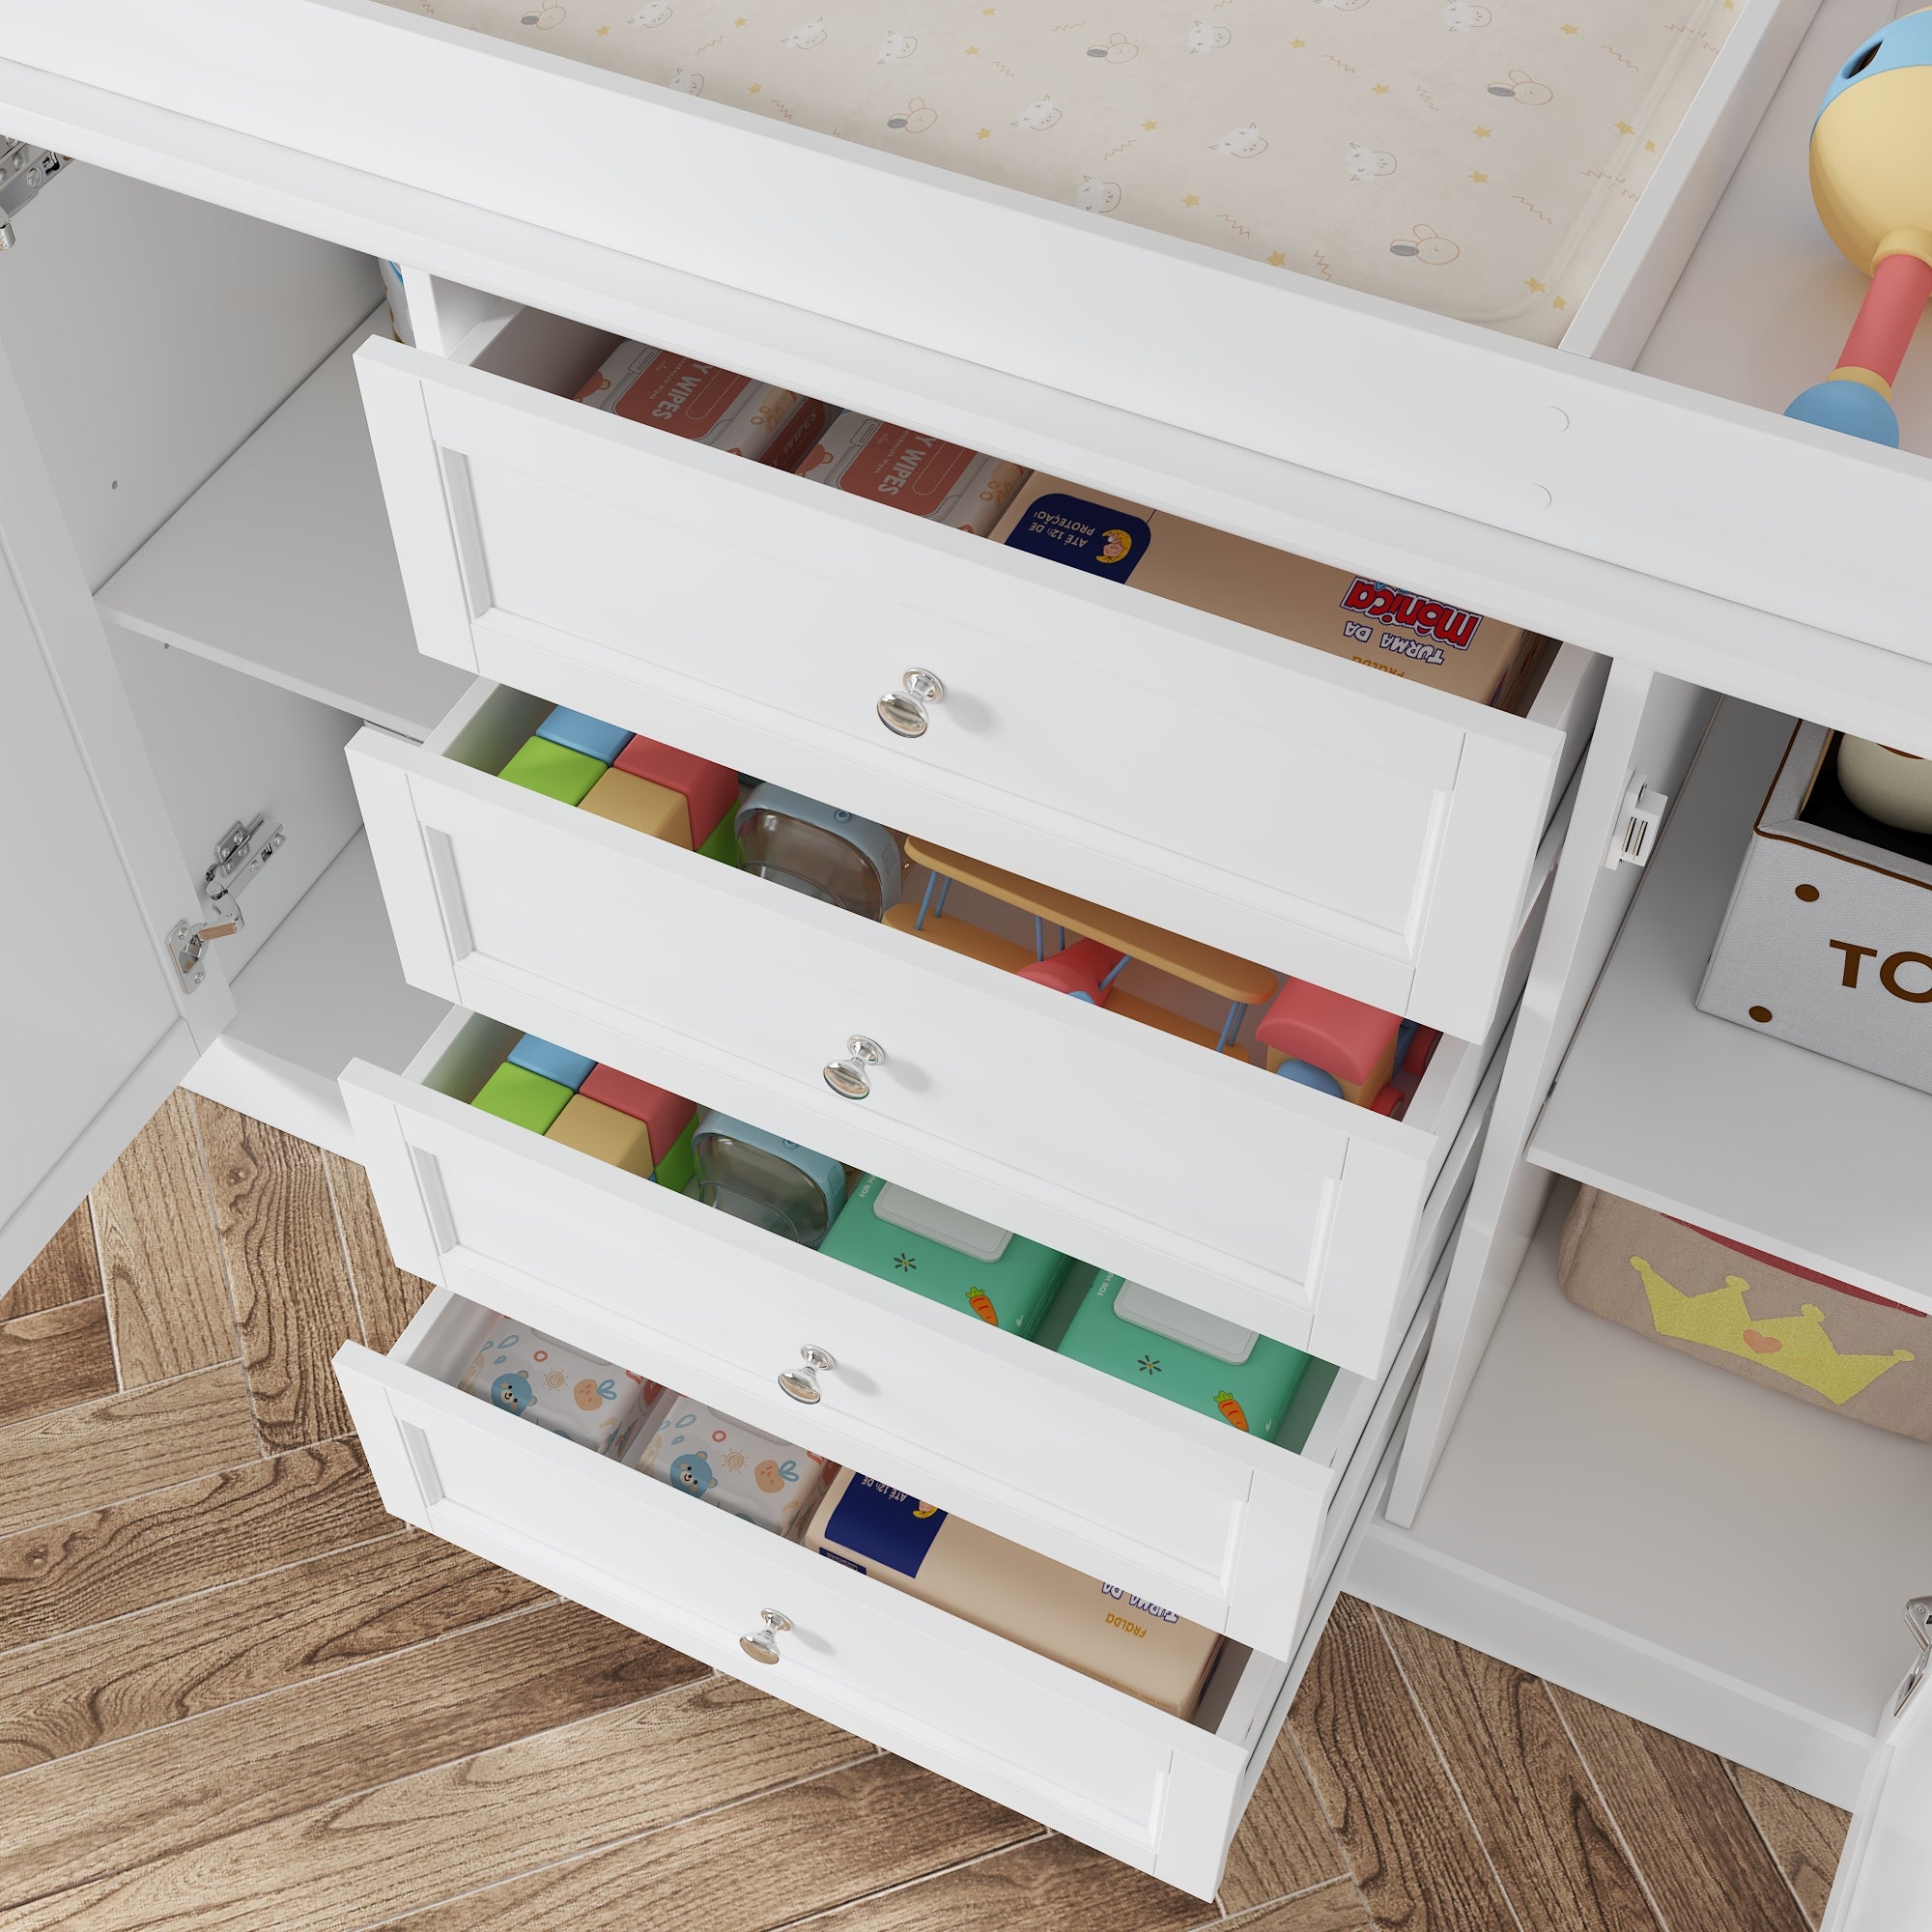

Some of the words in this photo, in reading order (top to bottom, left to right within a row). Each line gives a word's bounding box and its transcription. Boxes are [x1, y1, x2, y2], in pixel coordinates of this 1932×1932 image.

[651, 375, 702, 420] WIPES
[877, 448, 926, 497] WIPES
[1028, 522, 1045, 533] DE
[1033, 510, 1095, 536] PROTEÇÃO!
[1046, 527, 1065, 540] 12h
[1064, 534, 1089, 548] ATÉ
[1343, 620, 1374, 643] DA
[1379, 633, 1445, 665] TURMA
[862, 1476, 875, 1488] DE
[888, 1489, 908, 1502] ATÉ
